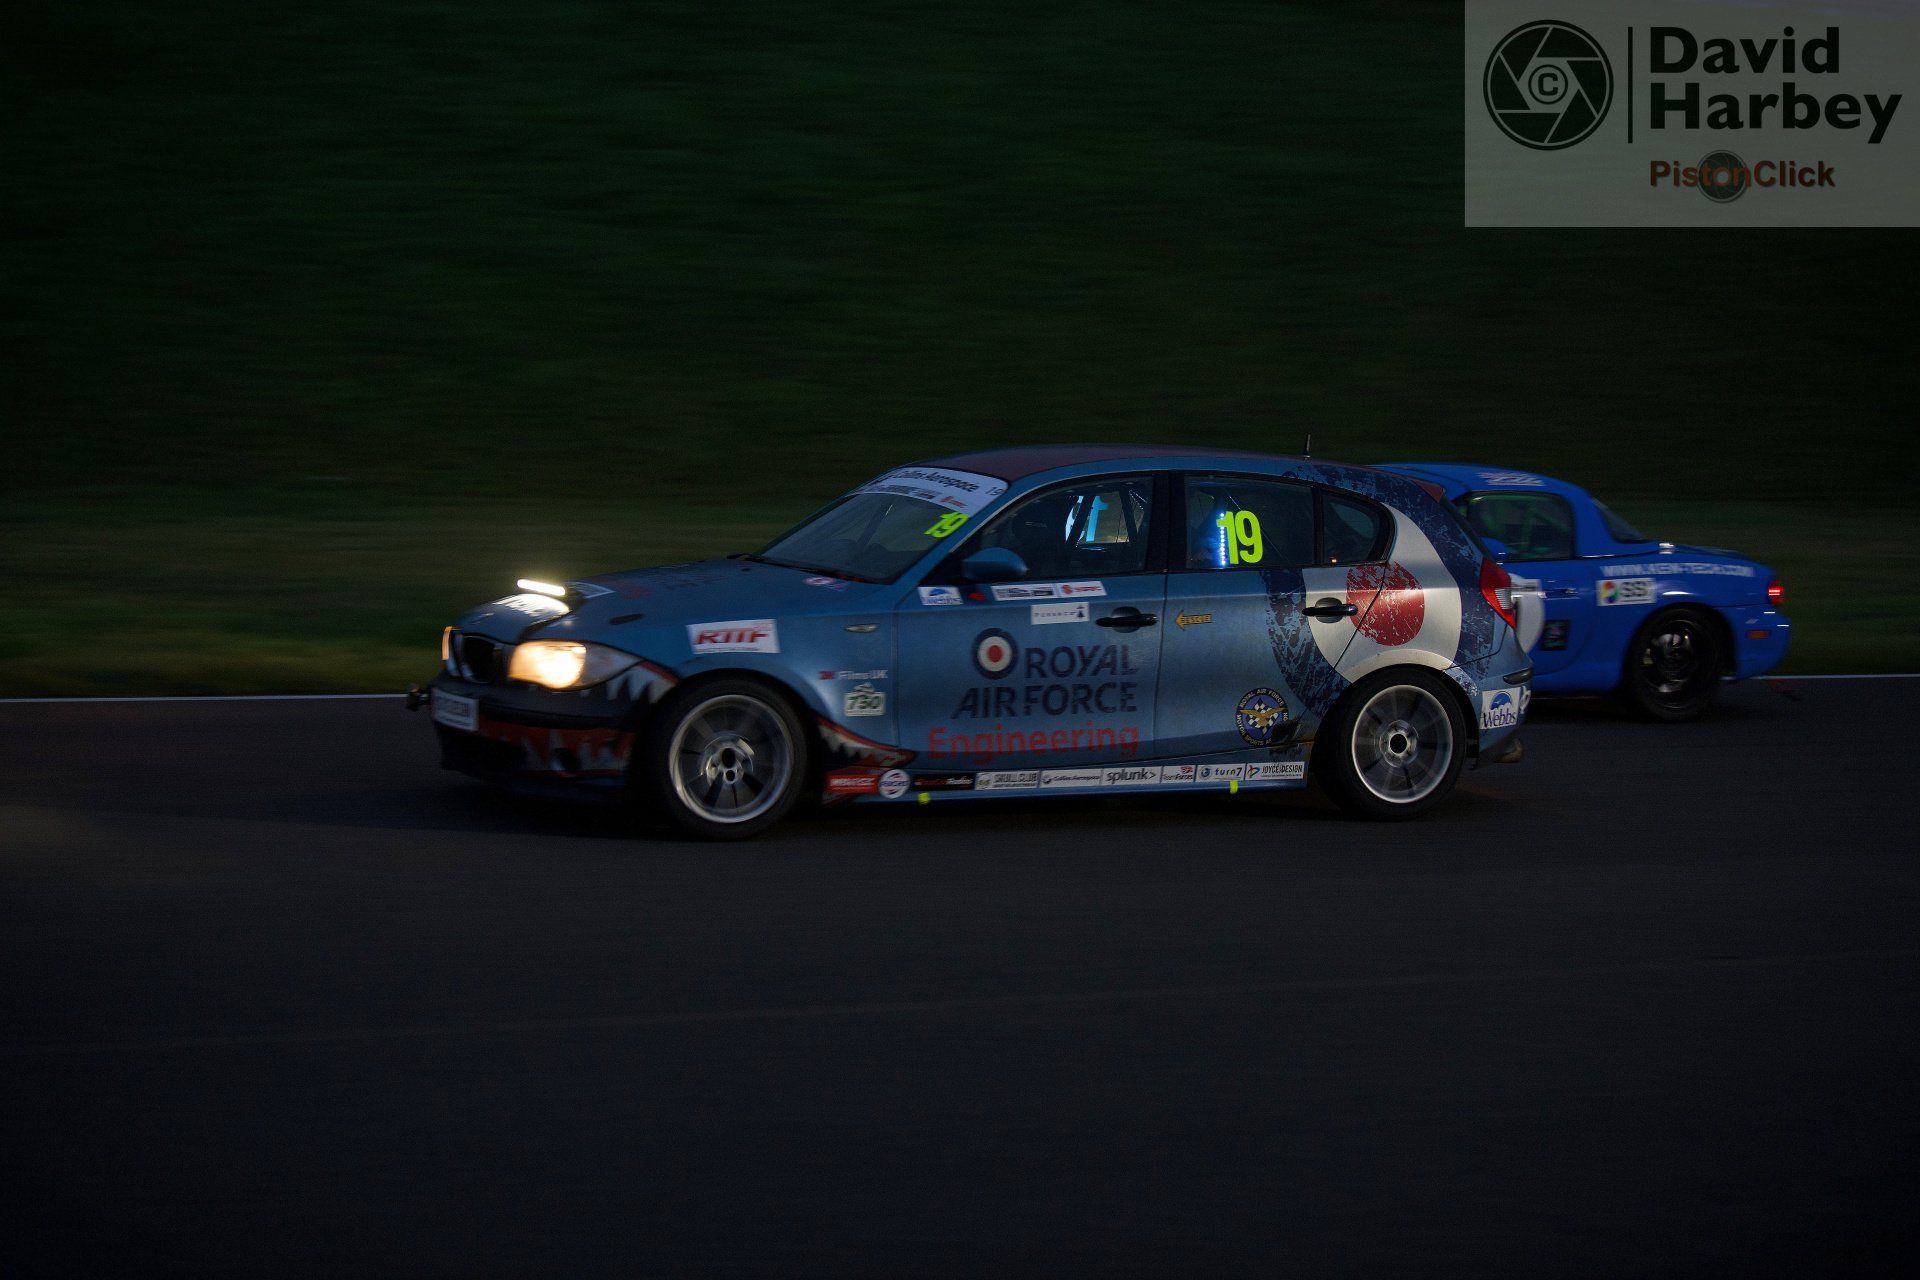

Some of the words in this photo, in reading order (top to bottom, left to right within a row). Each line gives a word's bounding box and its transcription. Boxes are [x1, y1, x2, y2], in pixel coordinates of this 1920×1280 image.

[926, 471, 980, 493] Aerospace
[923, 511, 970, 538] 19
[1216, 510, 1264, 565] 19
[1024, 645, 1140, 678] ROYAL
[952, 685, 1017, 719] AIR
[1023, 681, 1138, 716] FORCE
[1239, 691, 1256, 708] ROYAL
[1268, 690, 1285, 707] FORCE
[1480, 708, 1517, 728] Webbs
[928, 719, 1141, 765] Engineering
[1215, 767, 1242, 778] turn7
